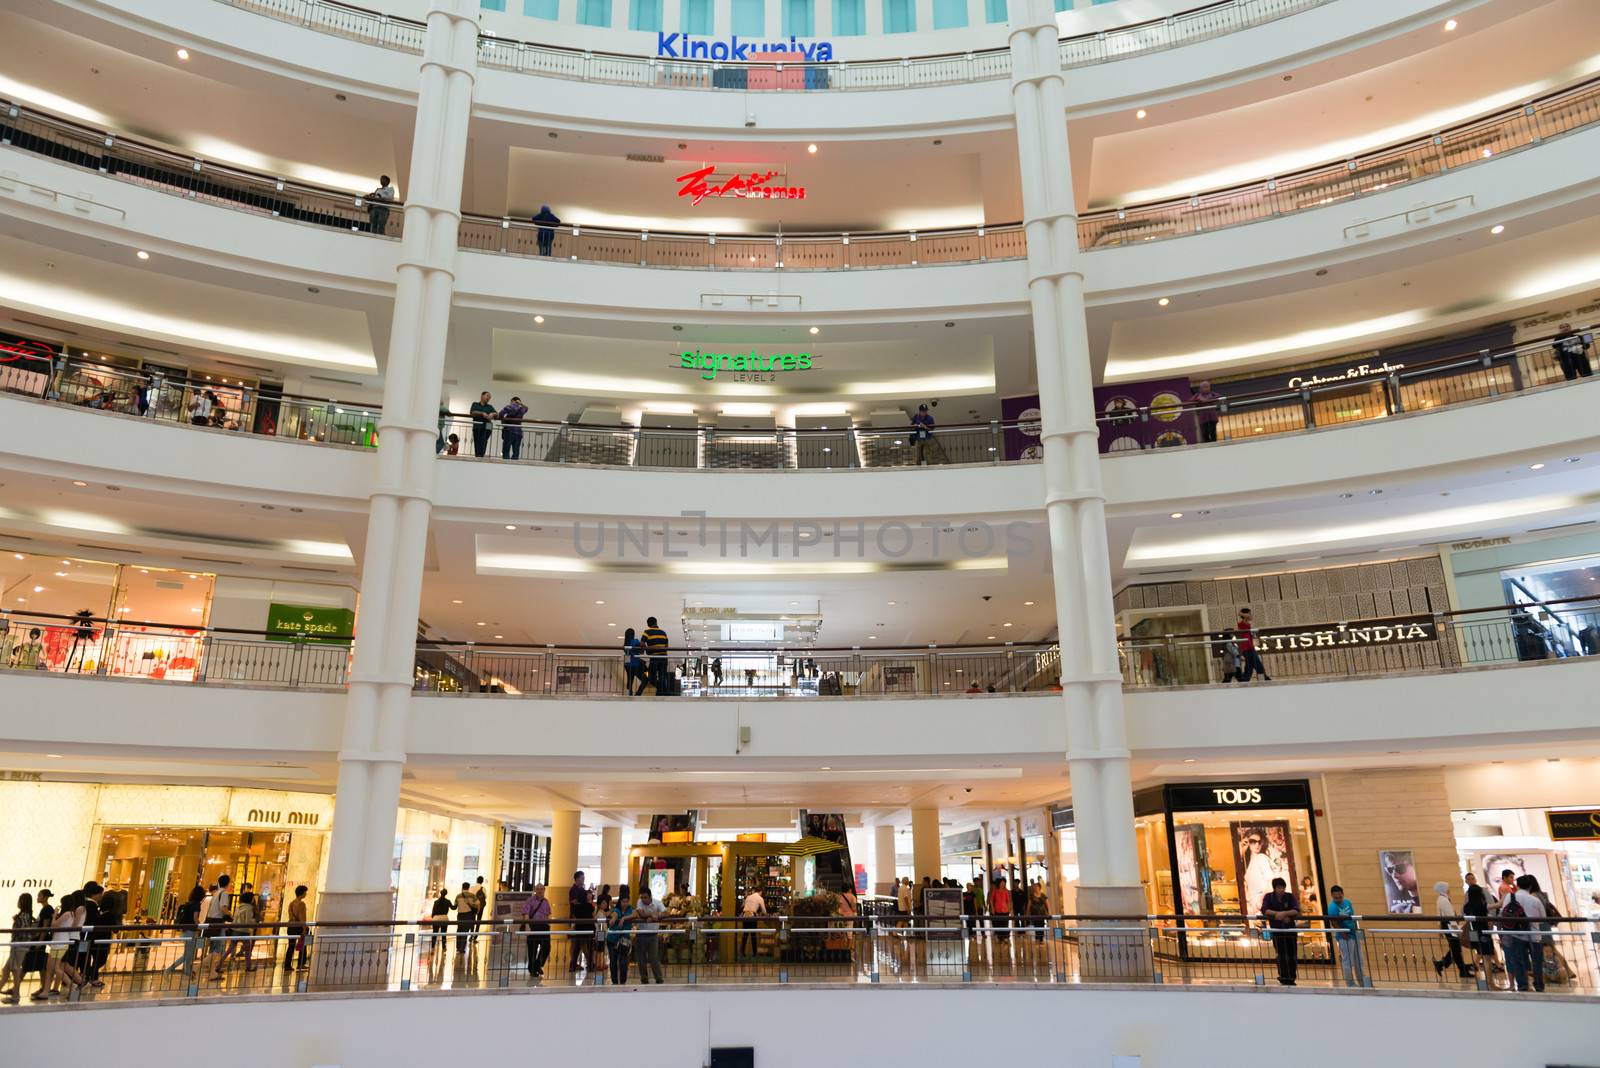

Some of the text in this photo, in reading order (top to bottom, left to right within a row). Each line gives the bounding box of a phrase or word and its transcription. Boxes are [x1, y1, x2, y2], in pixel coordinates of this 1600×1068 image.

[680, 350, 812, 380] signatures
[733, 374, 776, 382] LEVEL 2
[276, 619, 337, 634] kate spade
[1213, 788, 1262, 804] TOD'S
